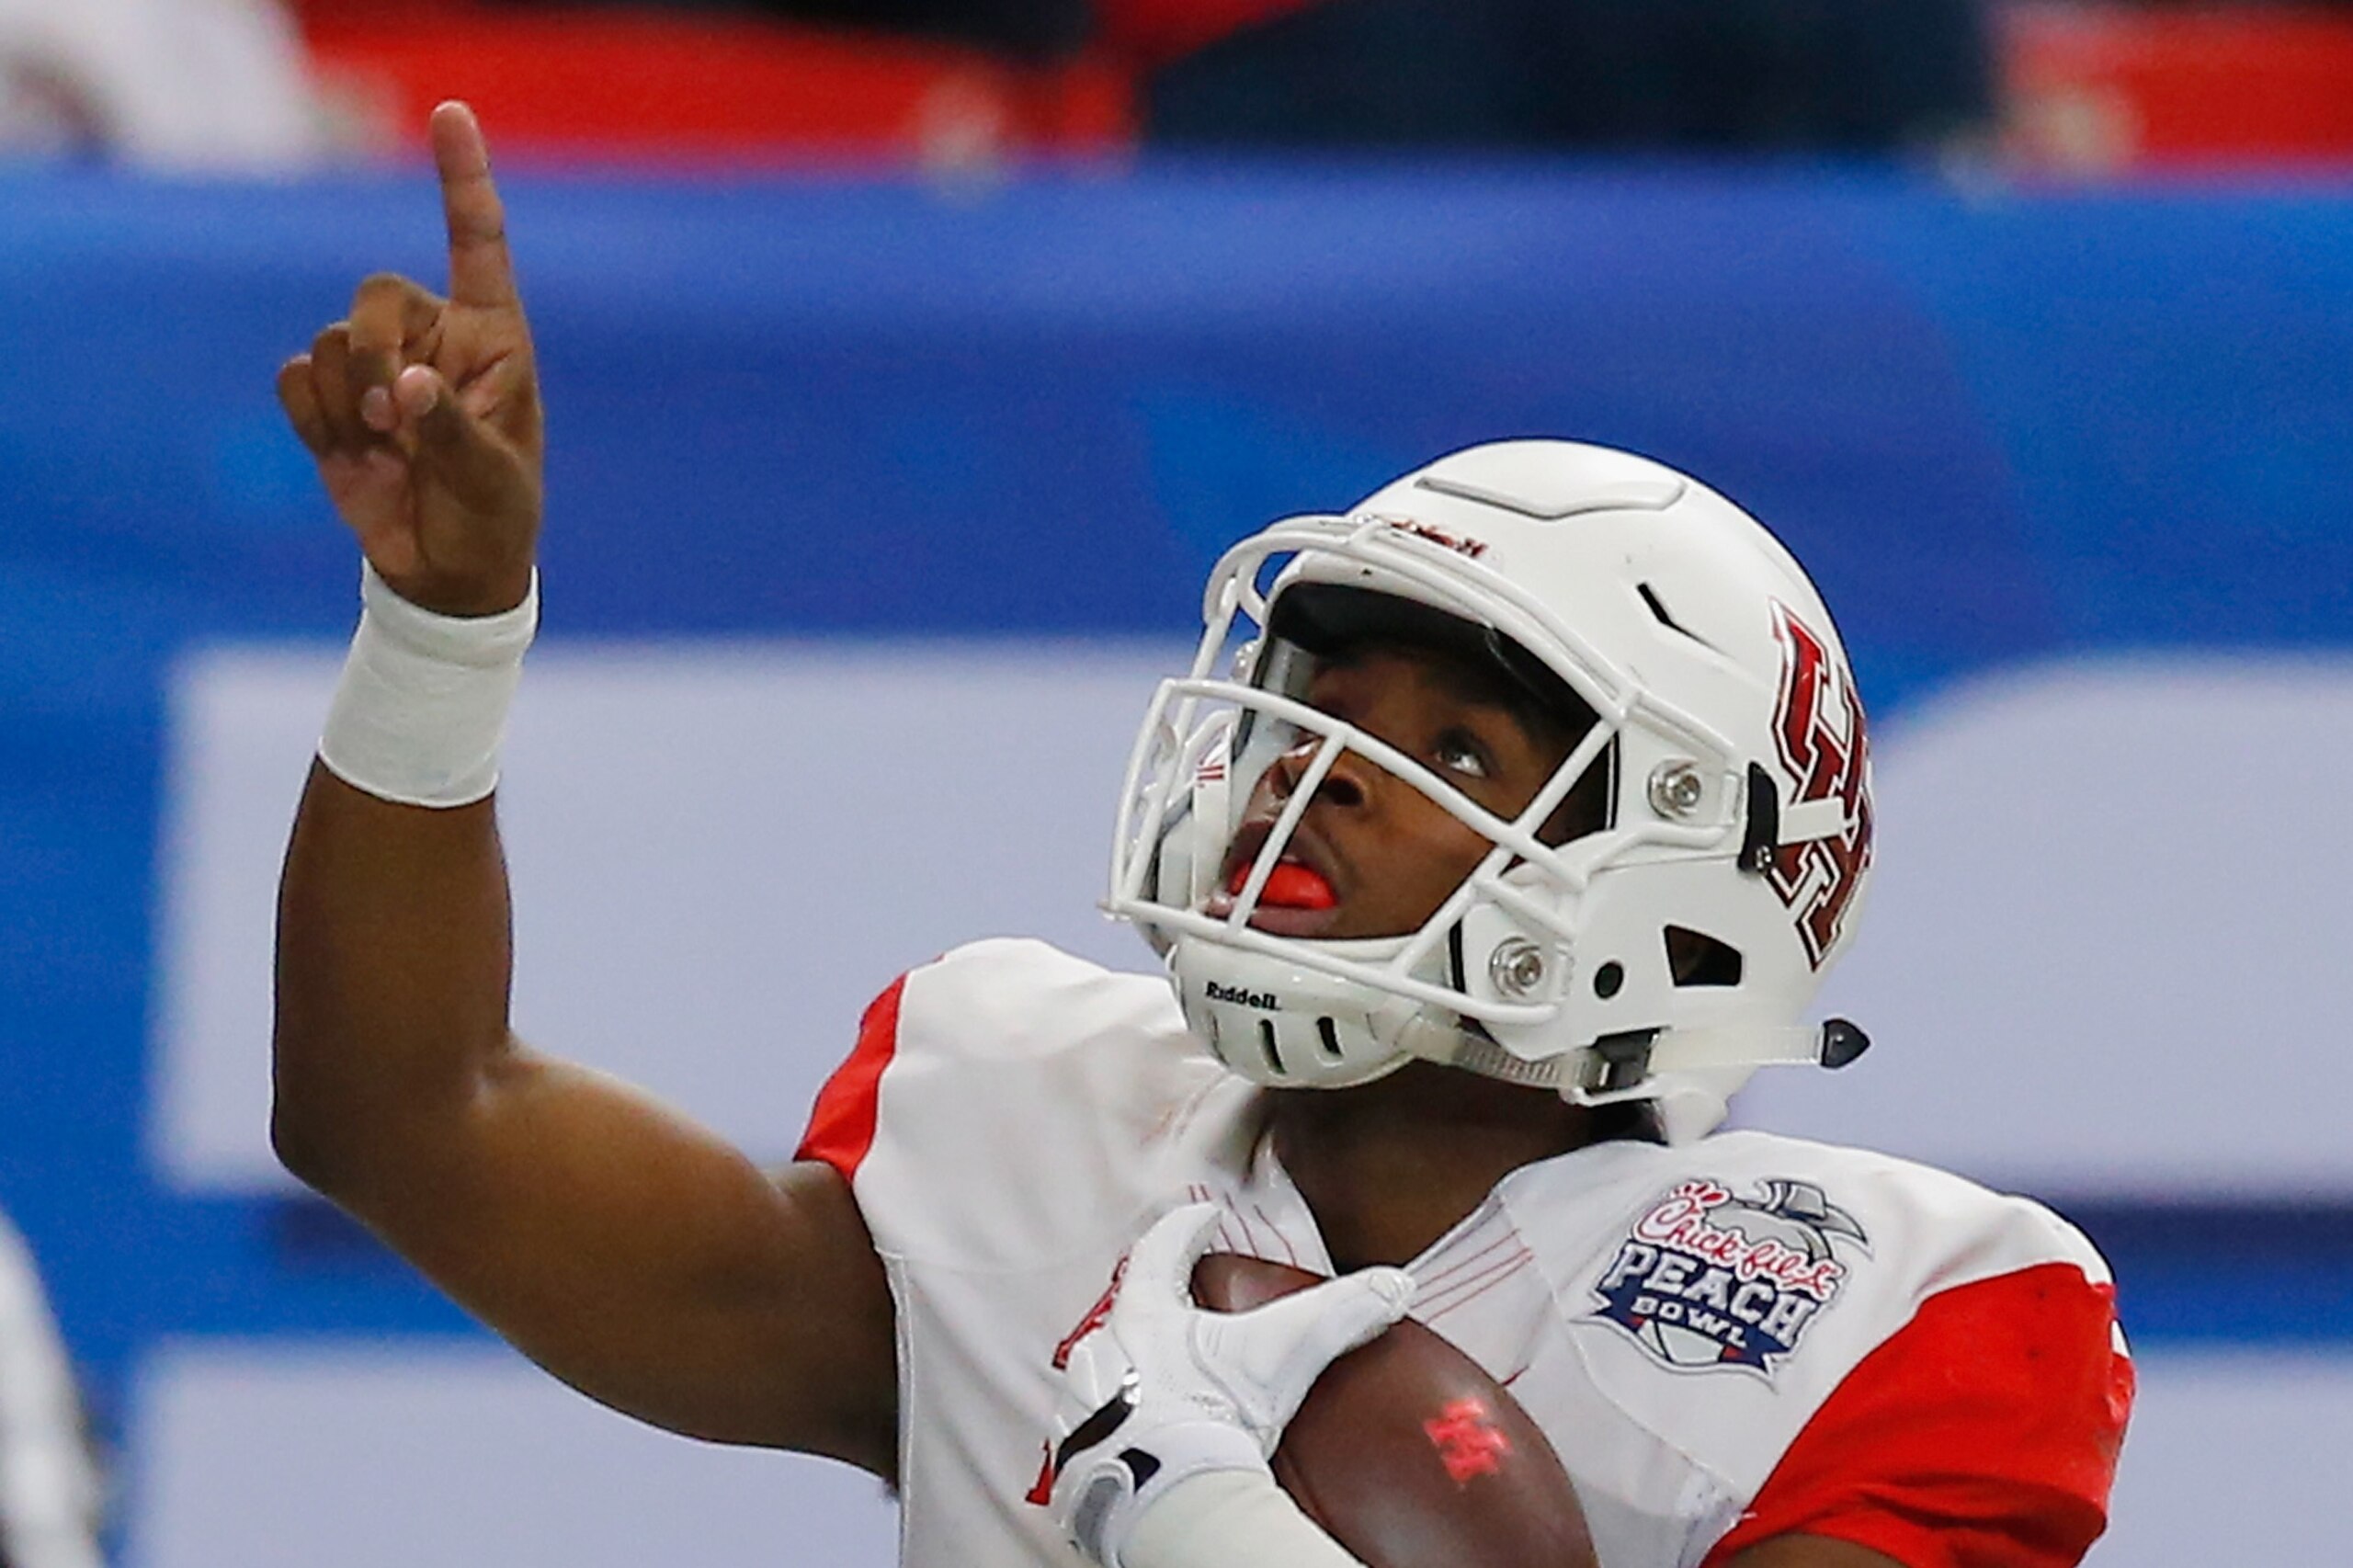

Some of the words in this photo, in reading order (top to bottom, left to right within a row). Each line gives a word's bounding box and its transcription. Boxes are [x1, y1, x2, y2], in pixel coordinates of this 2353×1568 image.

[1205, 980, 1277, 1010] Riddell
[1601, 1243, 1818, 1348] PEACH
[1630, 1296, 1747, 1347] BOWL
